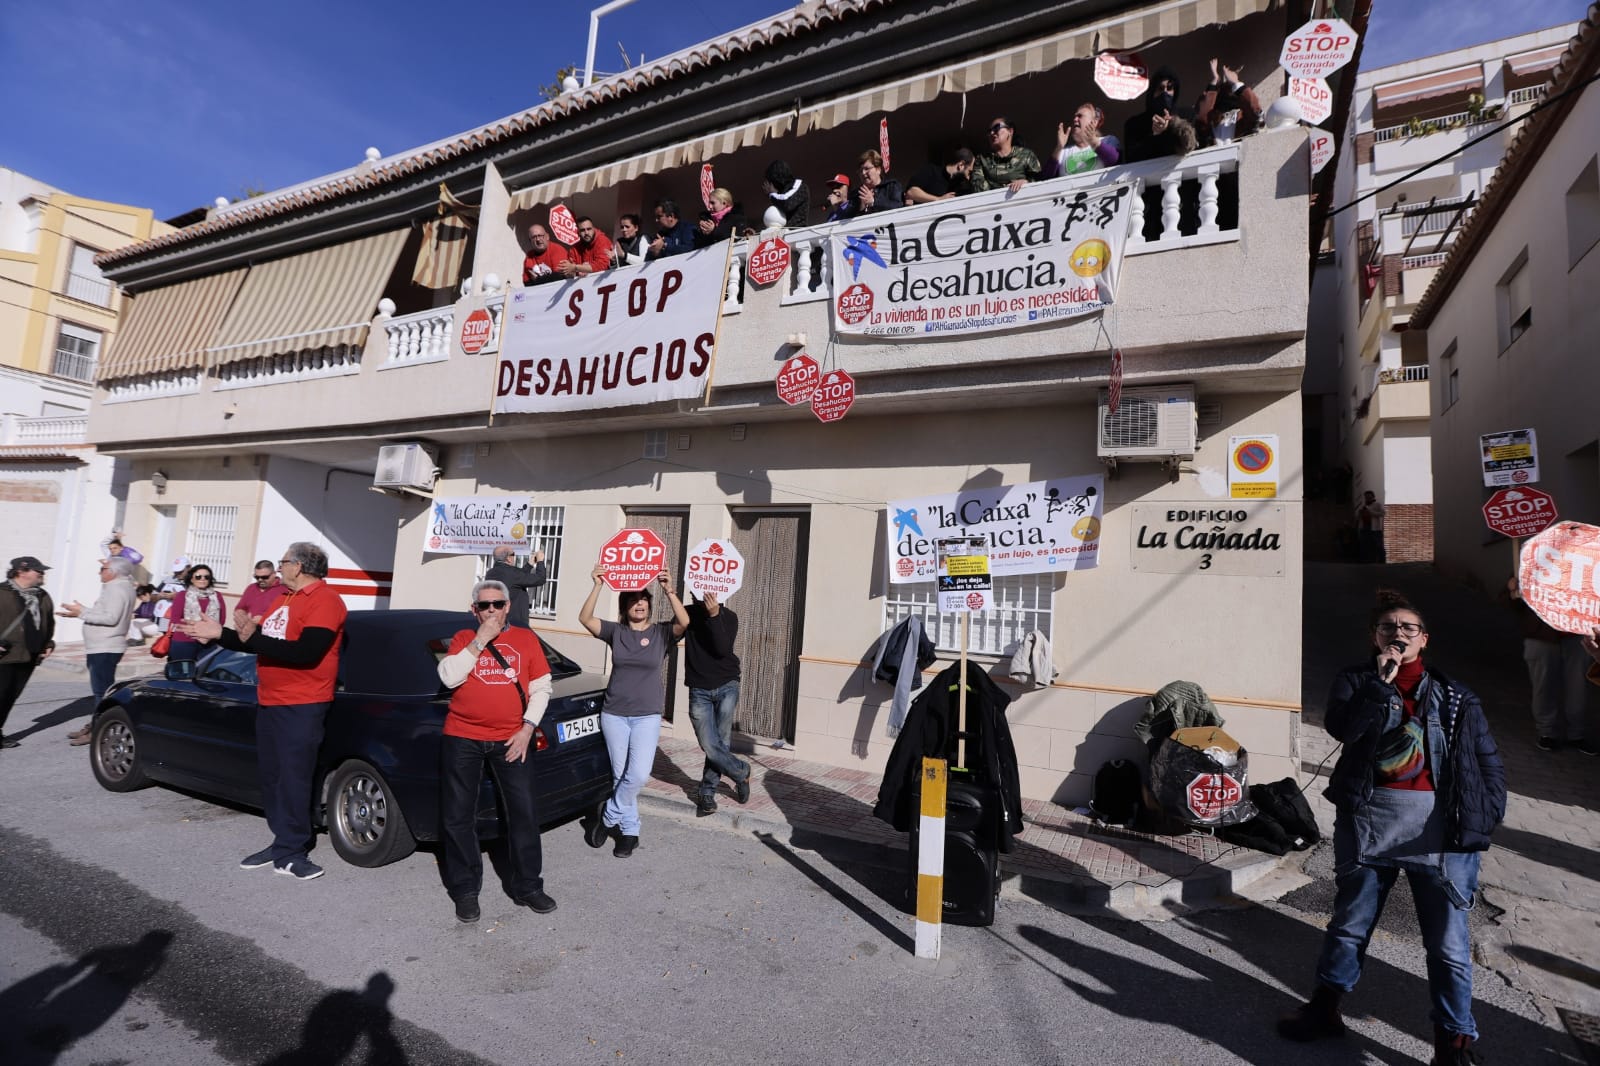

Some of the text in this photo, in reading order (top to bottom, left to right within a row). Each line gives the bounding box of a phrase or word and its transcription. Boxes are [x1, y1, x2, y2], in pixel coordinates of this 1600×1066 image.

[1288, 36, 1350, 53] STOP
[1286, 52, 1345, 61] Desahucios
[1291, 60, 1335, 69] Granada
[752, 247, 788, 267] STOP
[751, 260, 787, 274] Desahucios
[755, 267, 782, 279] Granada
[888, 253, 1067, 303] desahucia,
[565, 269, 683, 327] STOP
[841, 293, 870, 307] STOP
[870, 311, 882, 325] La
[885, 304, 928, 324] vivienda
[932, 307, 945, 321] no
[949, 304, 962, 318] es
[966, 302, 980, 317] un
[1010, 297, 1025, 312] es
[1028, 283, 1100, 309] necesidad
[463, 319, 490, 335] STOP
[496, 332, 715, 397] DESAHUCIOS
[779, 365, 817, 387] STOP
[780, 378, 818, 394] Desahucios
[785, 386, 814, 399] Granada
[814, 382, 852, 402] STOP
[814, 396, 851, 409] Desahucios
[819, 404, 846, 415] Granada
[1487, 497, 1549, 519] STOP
[1166, 510, 1248, 523] EDIFICIO
[1491, 511, 1553, 526] Desahucios
[1501, 519, 1548, 531] Granada
[1137, 525, 1281, 551] La Cañada
[603, 546, 662, 563] STOP
[998, 551, 1010, 559] un
[1037, 548, 1049, 556] es
[1052, 543, 1098, 555] necesida
[602, 563, 659, 571] Desahucios
[689, 555, 739, 575] STOP
[916, 559, 927, 567] La
[1198, 554, 1213, 570] 3
[608, 572, 651, 581] Granada
[688, 571, 736, 585] Desahucios
[1532, 545, 1600, 599] ST
[693, 581, 729, 593] Granada
[480, 656, 516, 667] STP
[565, 718, 594, 738] 7549
[1193, 787, 1238, 801] STOP
